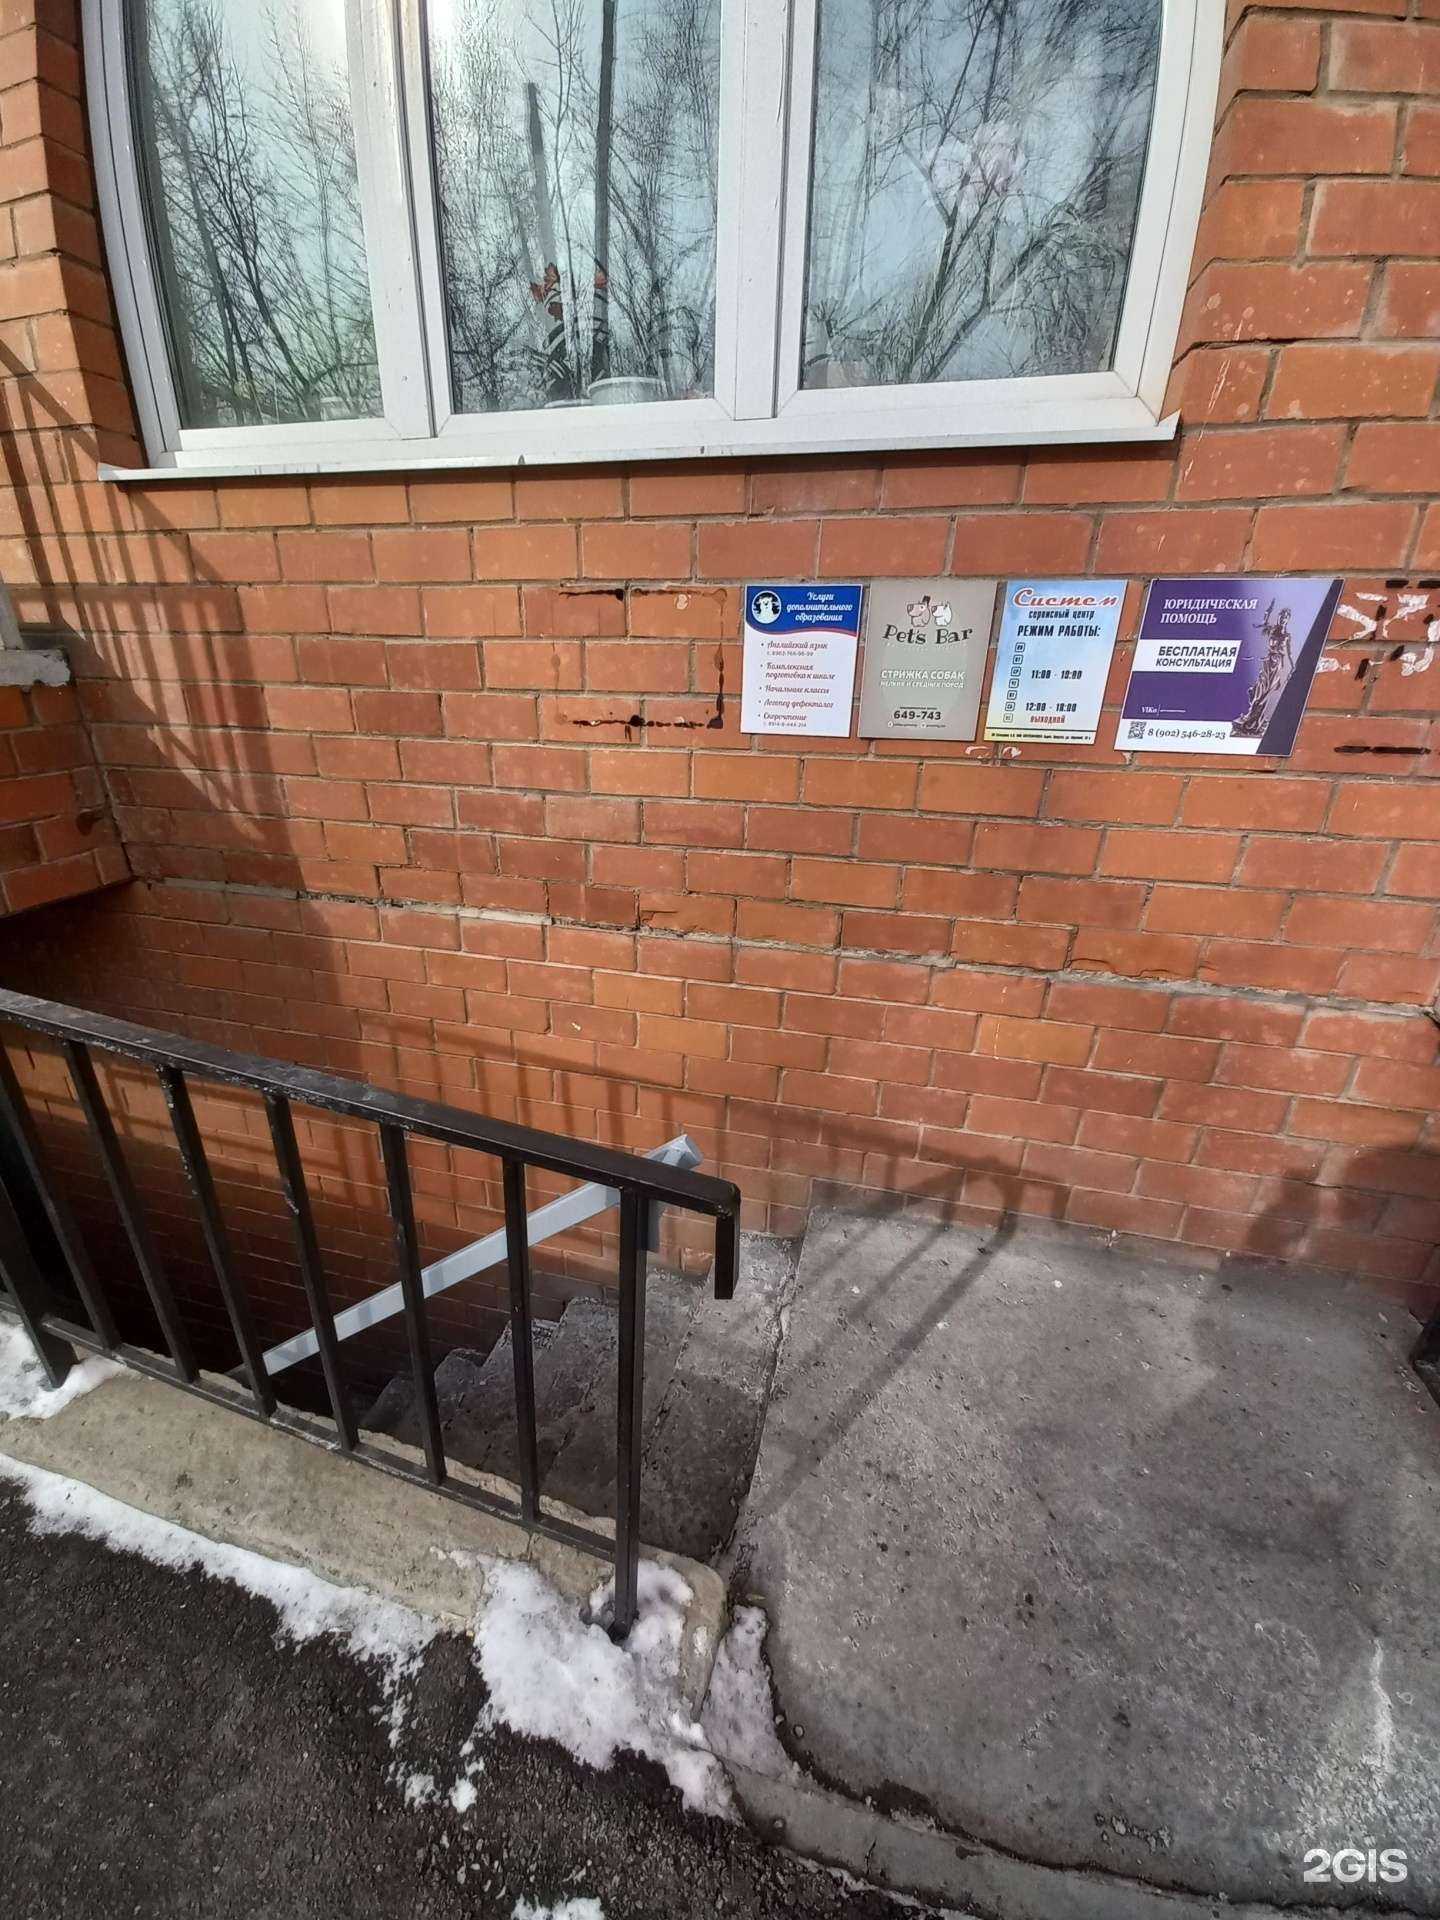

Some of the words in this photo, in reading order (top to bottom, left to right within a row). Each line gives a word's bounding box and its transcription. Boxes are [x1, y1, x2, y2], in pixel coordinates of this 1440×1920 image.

[807, 592, 834, 603] Услуги
[786, 604, 853, 612] дополнительного
[1163, 599, 1258, 610] ЮРИДИЧЕСКАЯ
[795, 612, 843, 623] образования
[1028, 609, 1070, 620] сервисный
[1072, 610, 1095, 620] центр
[1160, 613, 1217, 625] ПОМОЩЬ
[882, 623, 927, 645] Pet's
[935, 627, 973, 645] Bar
[1017, 625, 1055, 637] РЕЖИМ
[1057, 626, 1101, 637] РАБОТЫ:
[1158, 646, 1237, 657] БЕСПЛАТНАЯ
[1155, 658, 1232, 668] КОНСУЛЬТАЦИЯ
[881, 670, 929, 680] СТРИЖКА
[930, 671, 966, 681] СОБАК
[1031, 670, 1052, 679] 11:00
[1026, 702, 1047, 711] 12:00
[893, 710, 942, 721] 649-743
[1147, 728, 1154, 736] 8
[1155, 729, 1180, 738] (902)
[1181, 730, 1226, 739] 546-28-23
